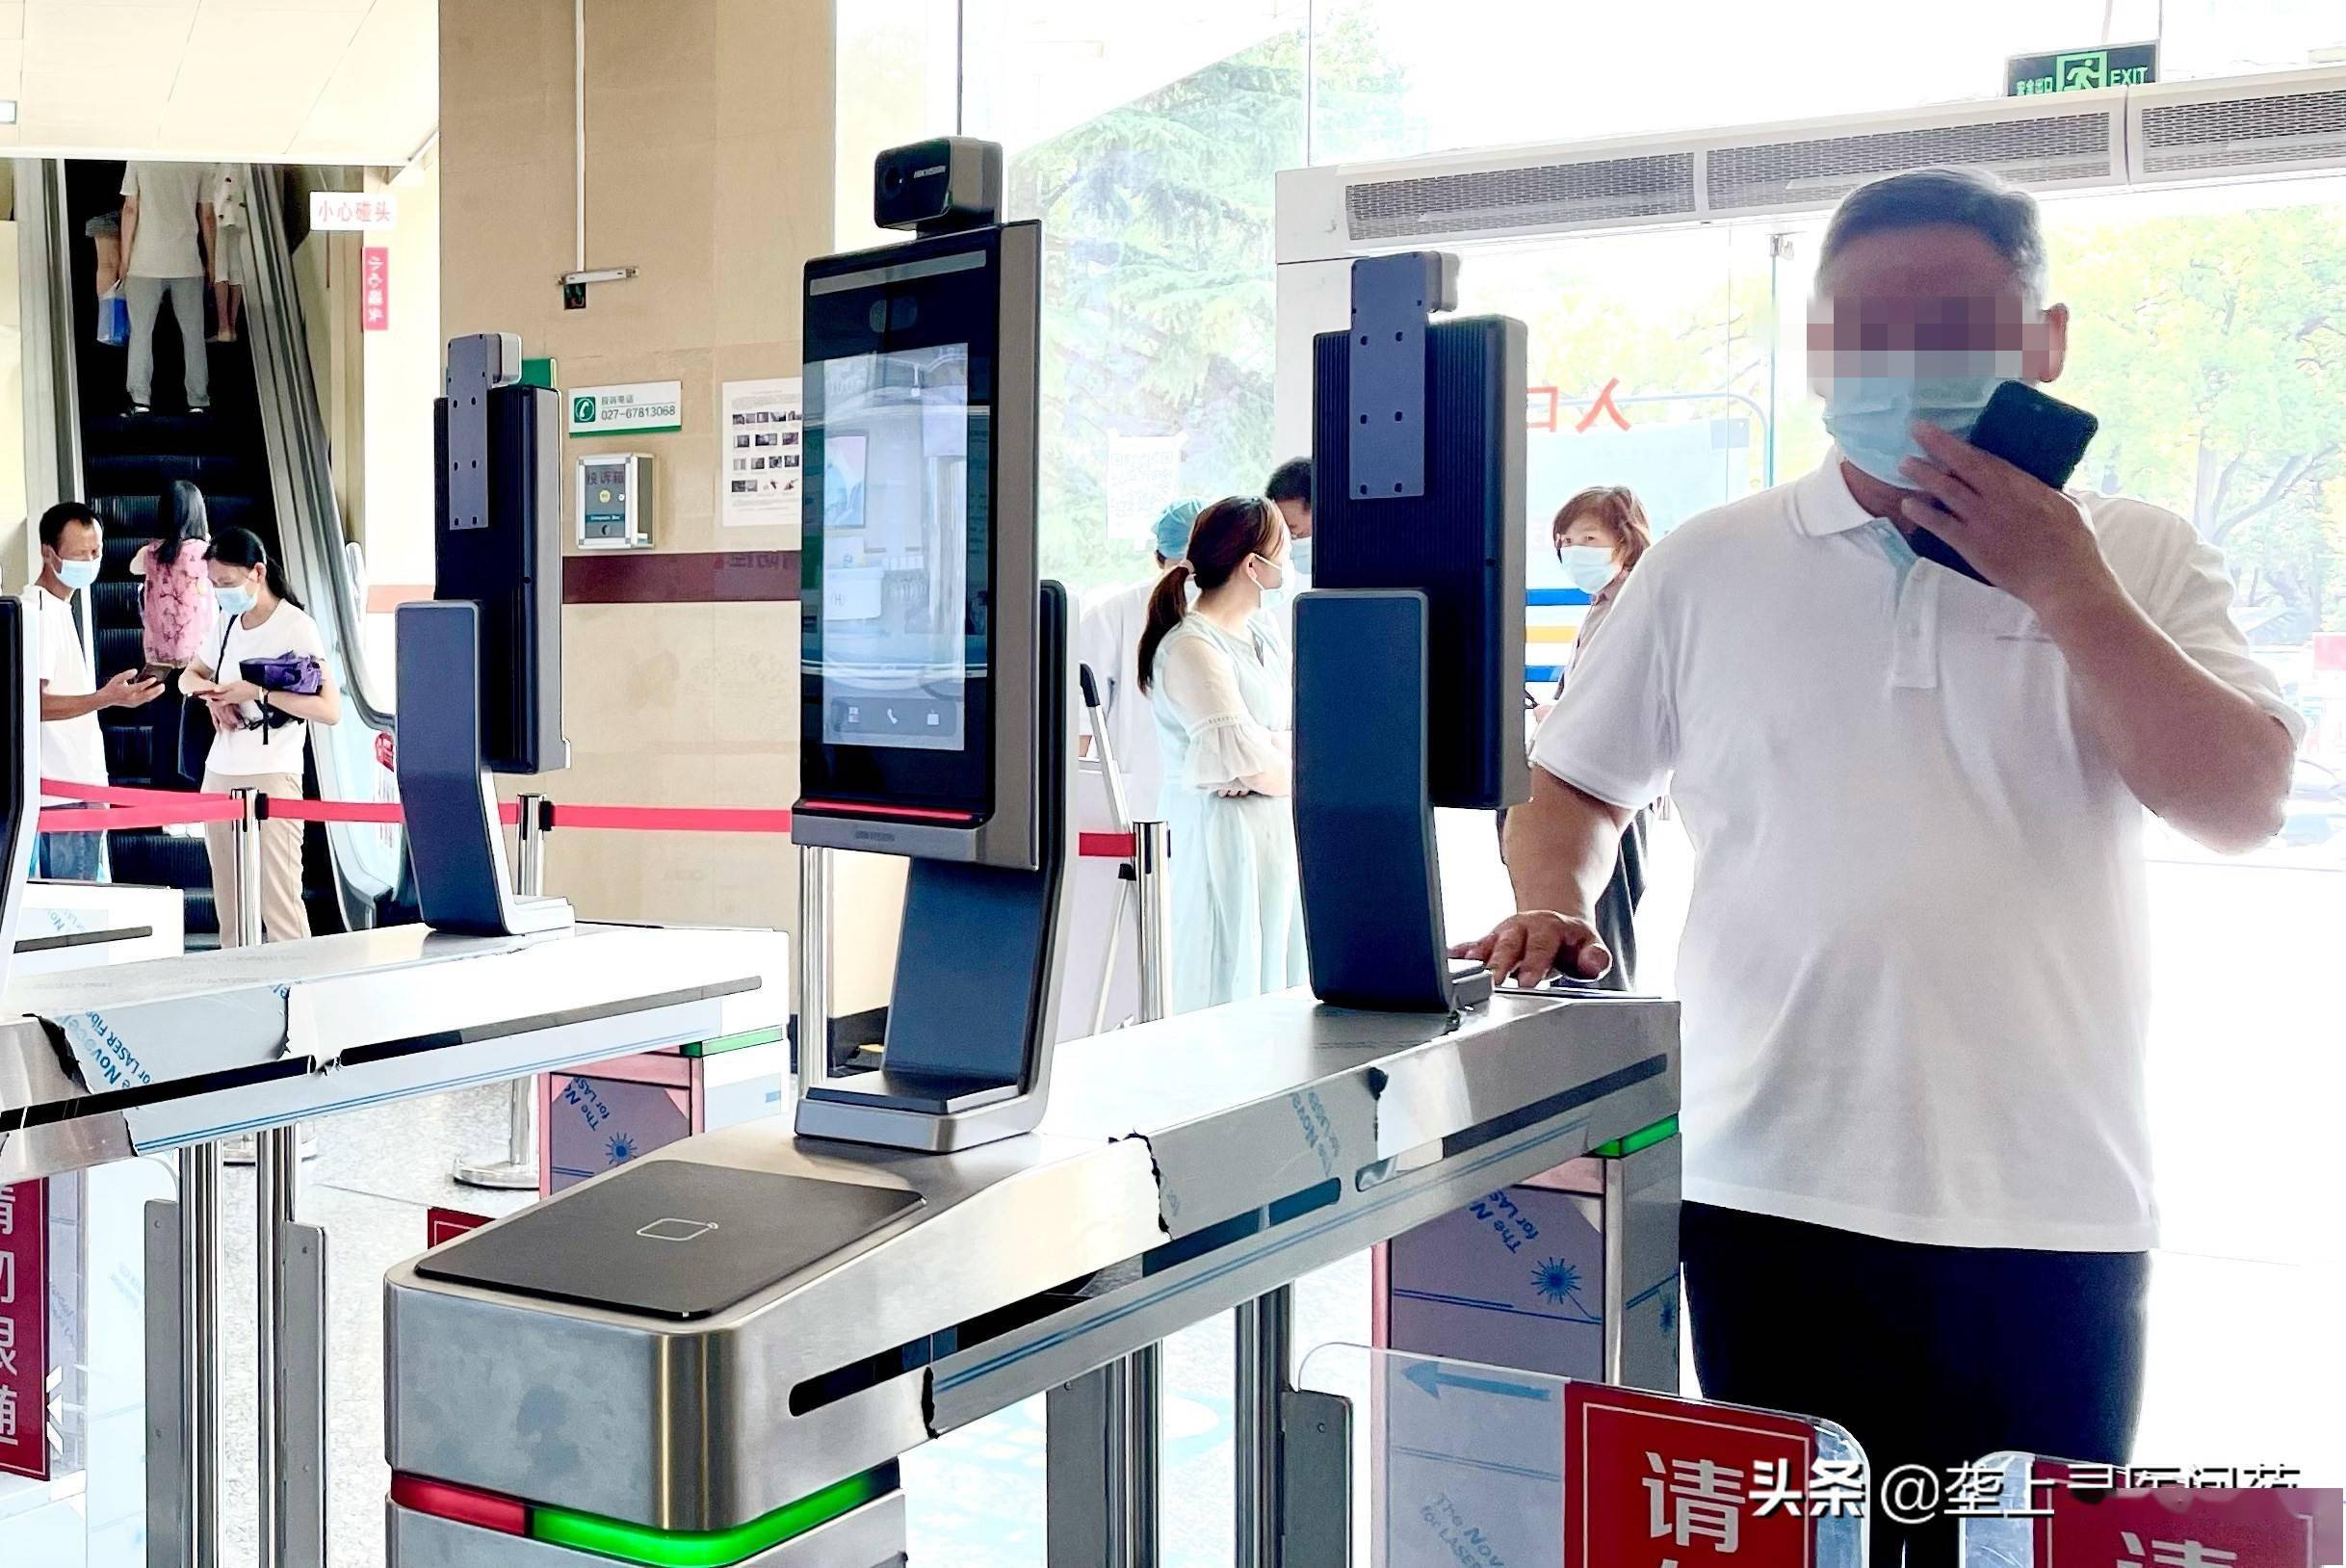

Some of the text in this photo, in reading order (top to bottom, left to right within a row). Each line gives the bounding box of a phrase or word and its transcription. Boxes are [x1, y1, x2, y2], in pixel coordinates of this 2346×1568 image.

[2017, 76, 2053, 96] 安全出口
[2110, 65, 2149, 87] EXIT
[318, 199, 391, 223] 小心碰头
[601, 405, 676, 421] 027-67813068
[107, 1032, 141, 1074] LASER
[138, 1070, 151, 1085] or
[574, 1077, 611, 1120] for LAS
[581, 1104, 599, 1132] The
[1488, 1189, 1539, 1240] for LAS
[1494, 1219, 1522, 1254] The
[1641, 1450, 1746, 1568] 请
